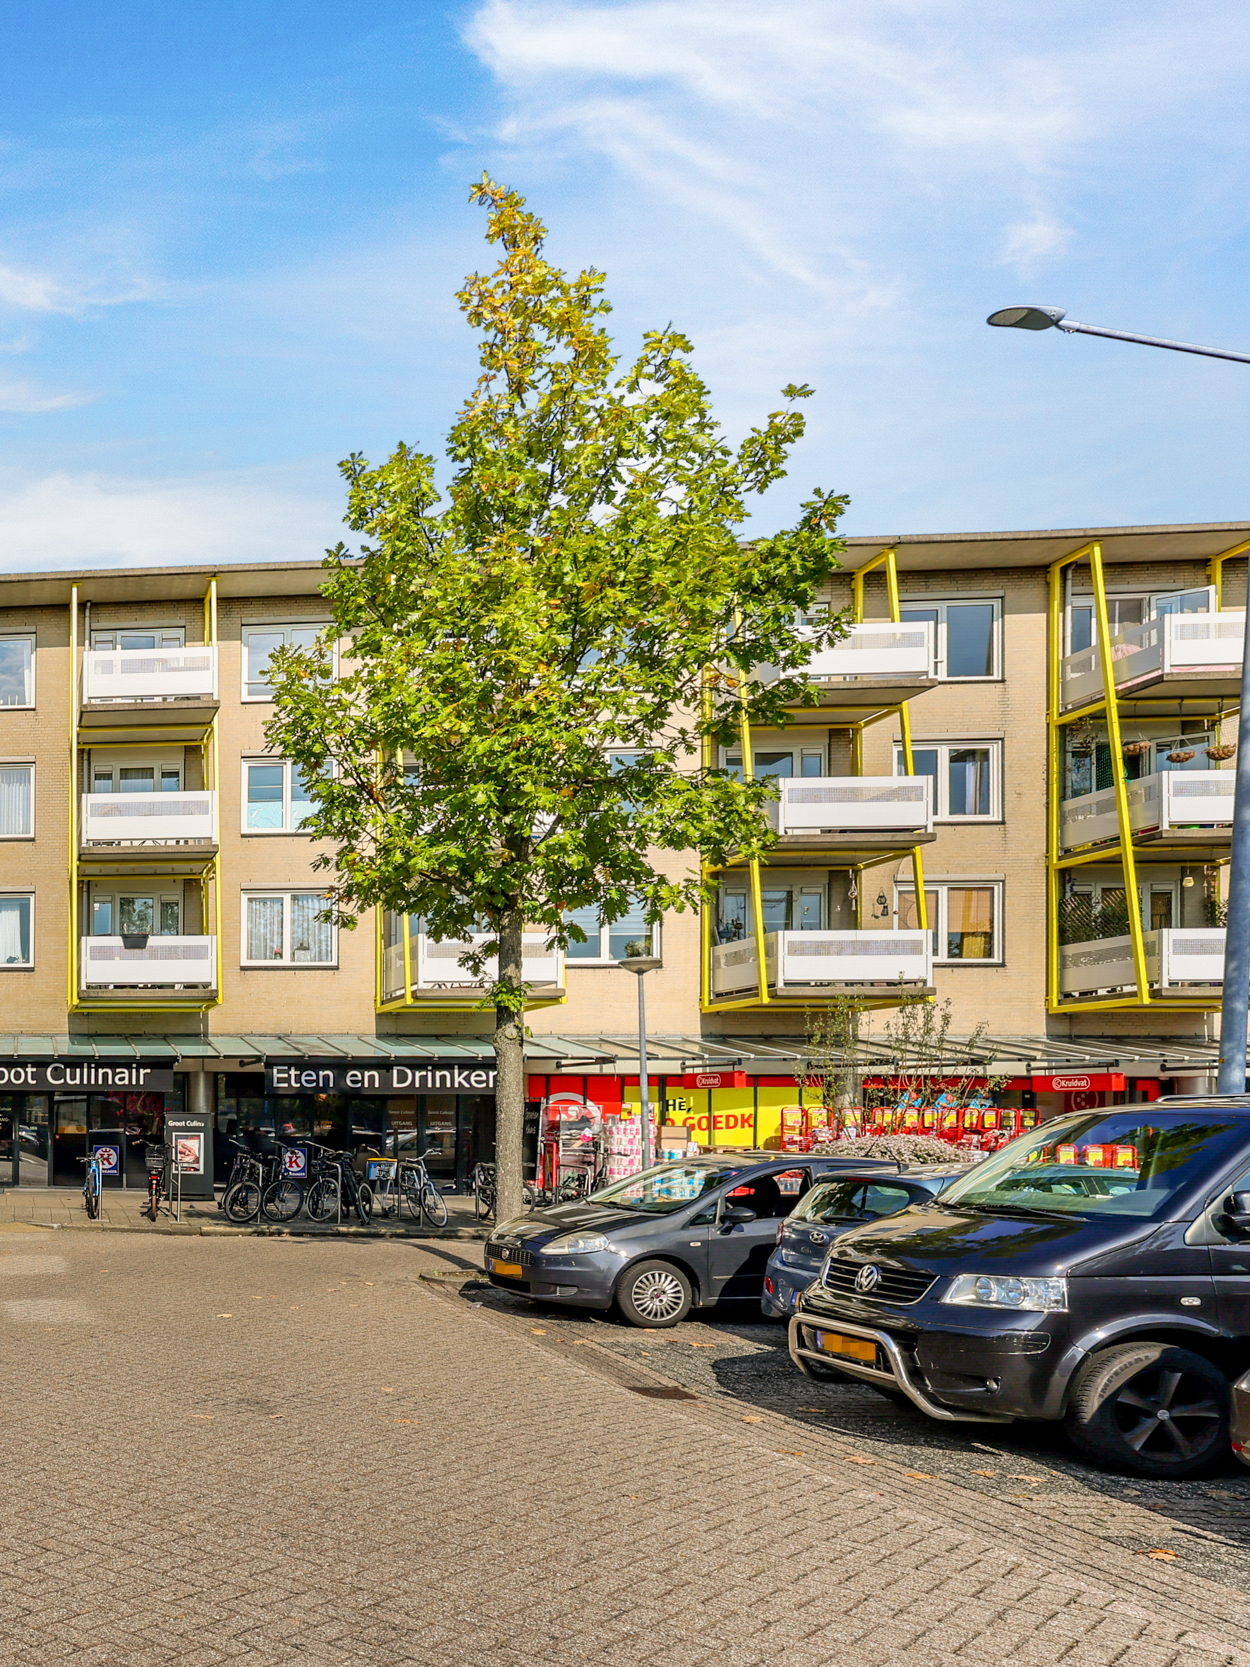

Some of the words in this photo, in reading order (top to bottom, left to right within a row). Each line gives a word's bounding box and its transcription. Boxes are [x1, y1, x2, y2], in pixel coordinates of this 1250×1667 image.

[46, 1062, 151, 1085] Culinair
[272, 1065, 334, 1088] Eten
[346, 1070, 380, 1088] en
[1061, 1079, 1088, 1087] Kruidvat
